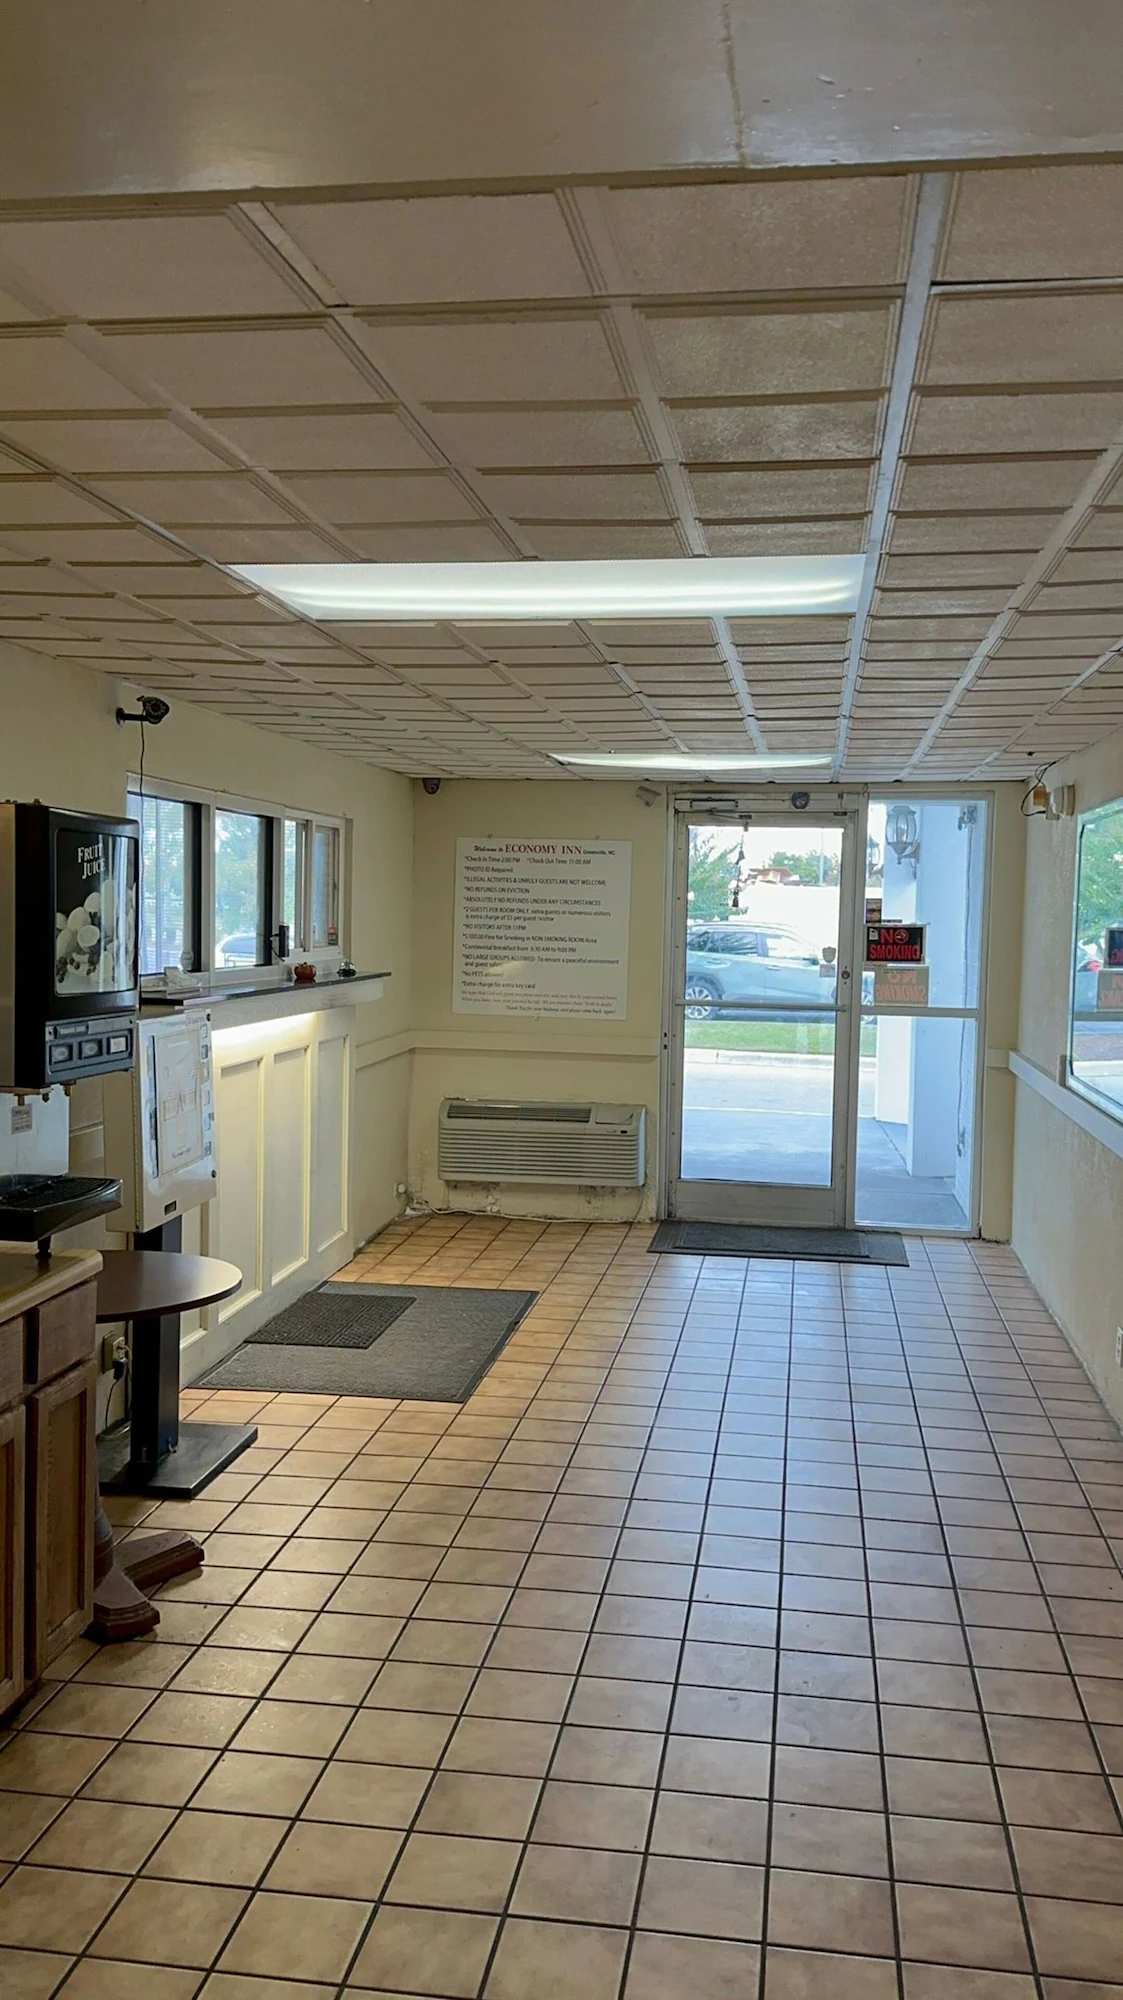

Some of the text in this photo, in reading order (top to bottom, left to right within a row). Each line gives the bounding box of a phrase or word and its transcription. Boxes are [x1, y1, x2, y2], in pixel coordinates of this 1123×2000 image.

[78, 844, 103, 863] FRUIT
[505, 844, 556, 853] ECONOMY
[562, 845, 582, 854] INN
[82, 859, 105, 879] JUICE
[880, 928, 908, 944] NO
[869, 944, 920, 960] SMOKING
